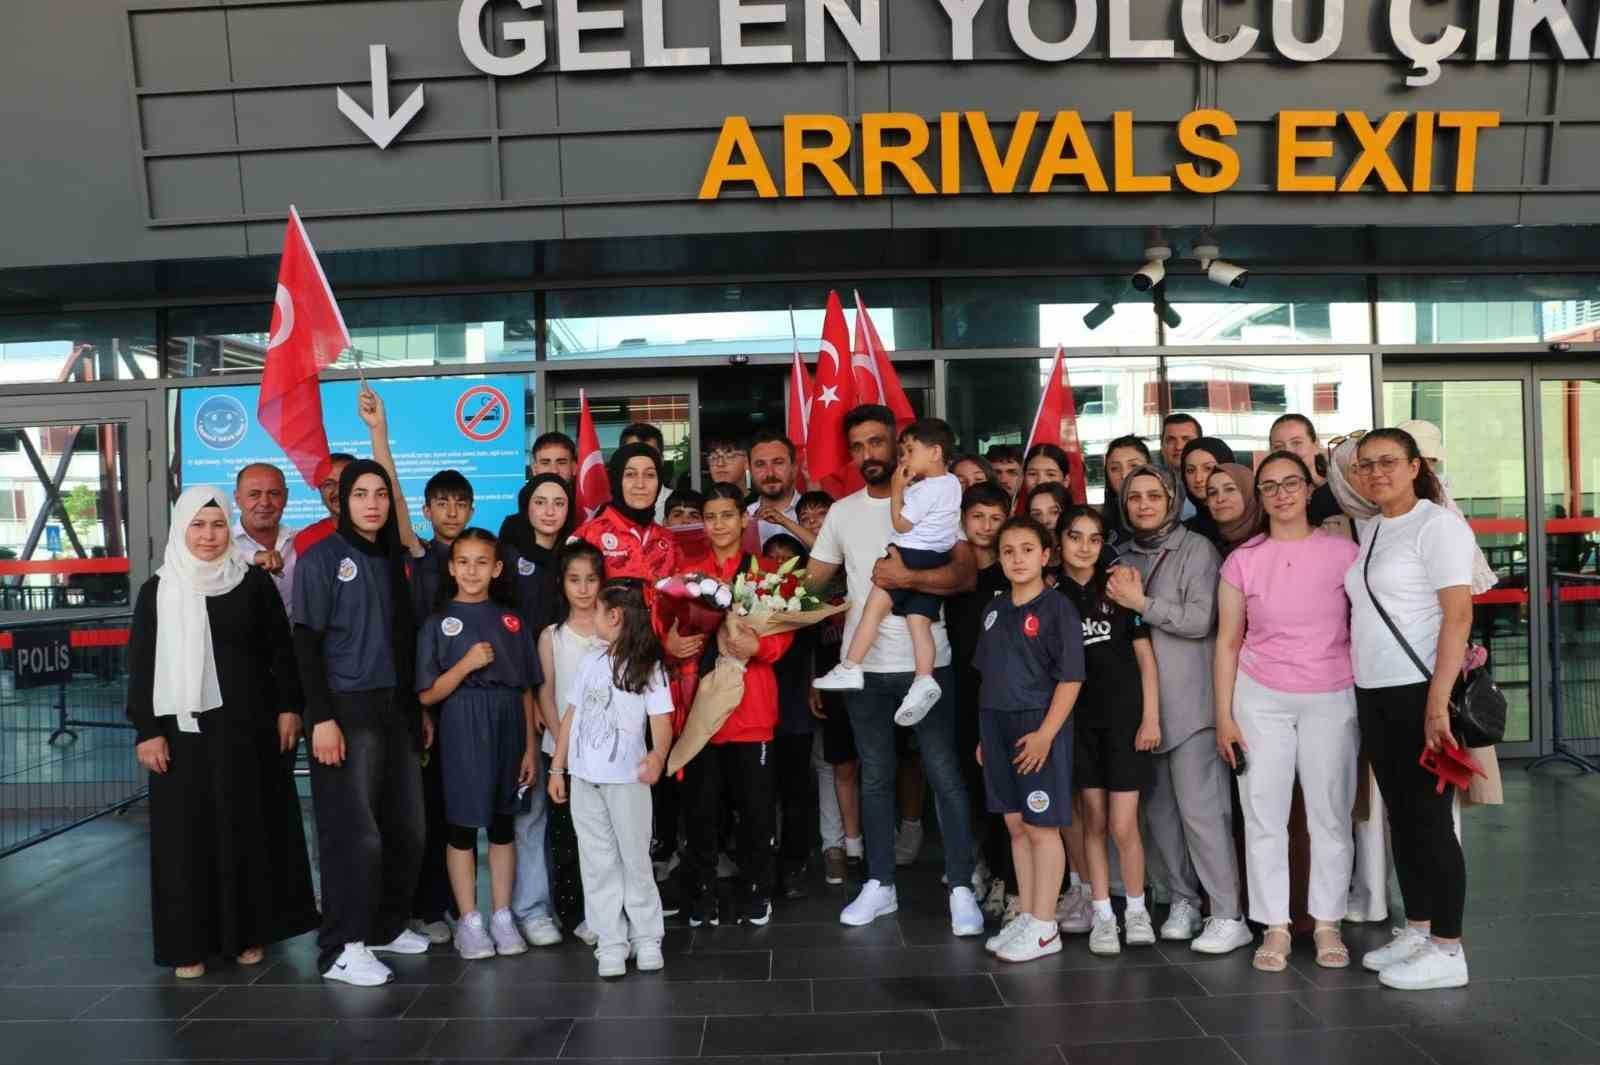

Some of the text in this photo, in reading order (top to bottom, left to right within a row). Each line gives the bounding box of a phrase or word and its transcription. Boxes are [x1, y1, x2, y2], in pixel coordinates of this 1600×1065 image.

[458, 0, 1600, 86] GELEN YOLCU ÇIK
[699, 110, 1500, 200] ARRIVALS EXIT
[17, 640, 71, 676] POLİS
